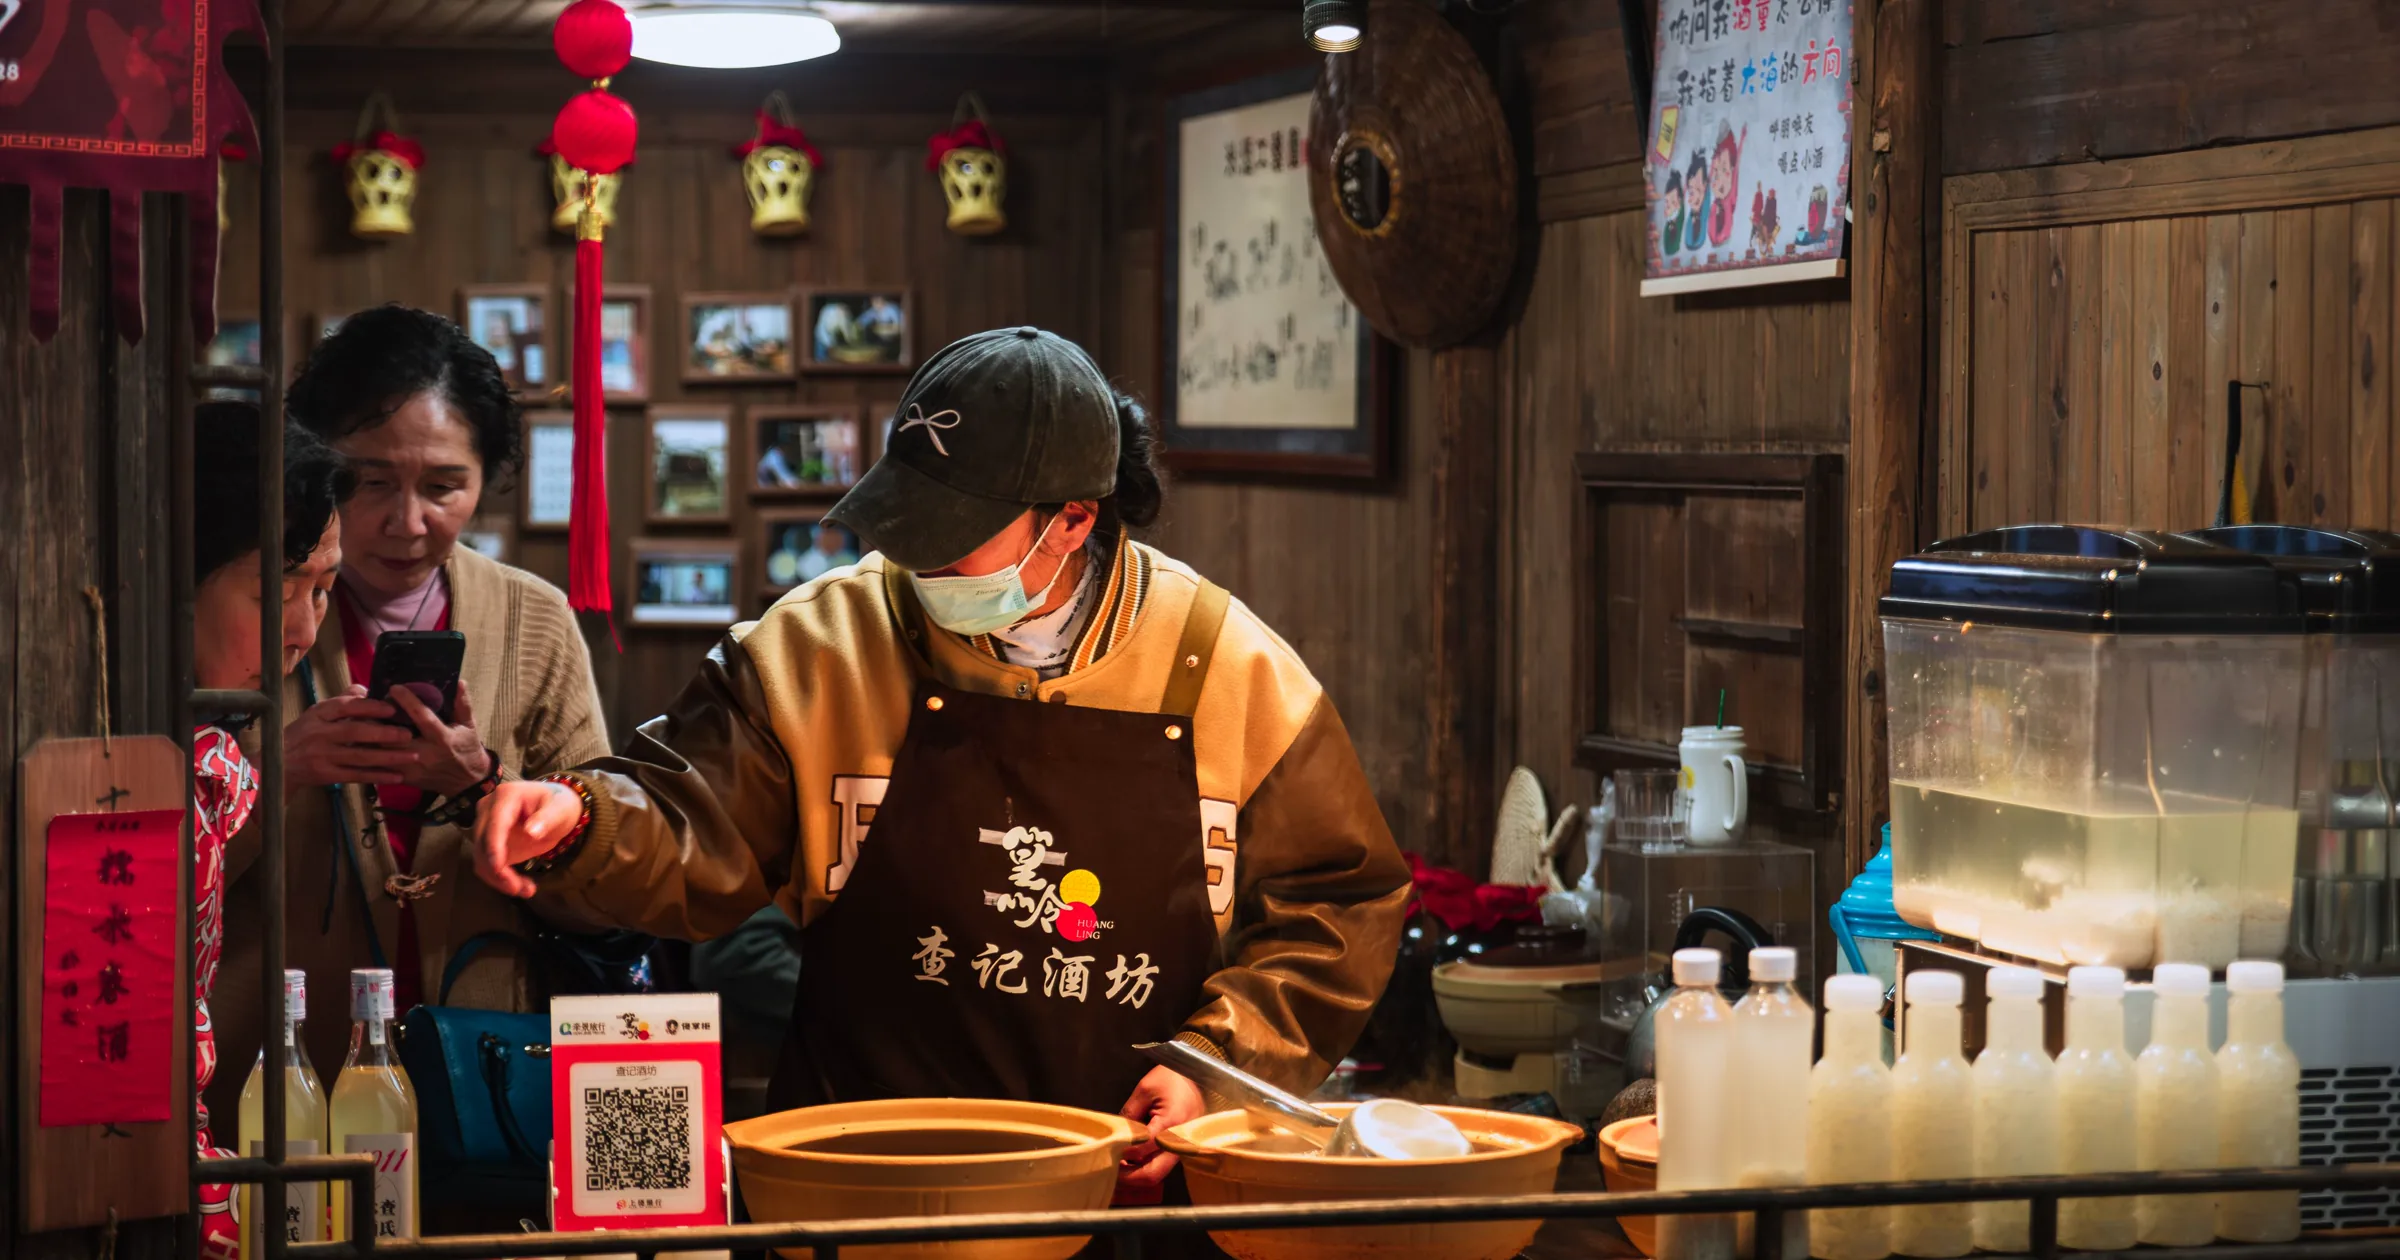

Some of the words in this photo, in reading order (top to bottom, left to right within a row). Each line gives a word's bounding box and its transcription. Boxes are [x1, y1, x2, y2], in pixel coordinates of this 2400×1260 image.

[1676, 37, 1842, 107] 我指着大海的方向
[1777, 146, 1824, 175] 喝点小酒
[1077, 918, 1115, 930] HUANG
[1075, 930, 1101, 940] LING
[911, 925, 1160, 1010] 查记酒坊
[615, 1065, 658, 1077] 查记酒坊
